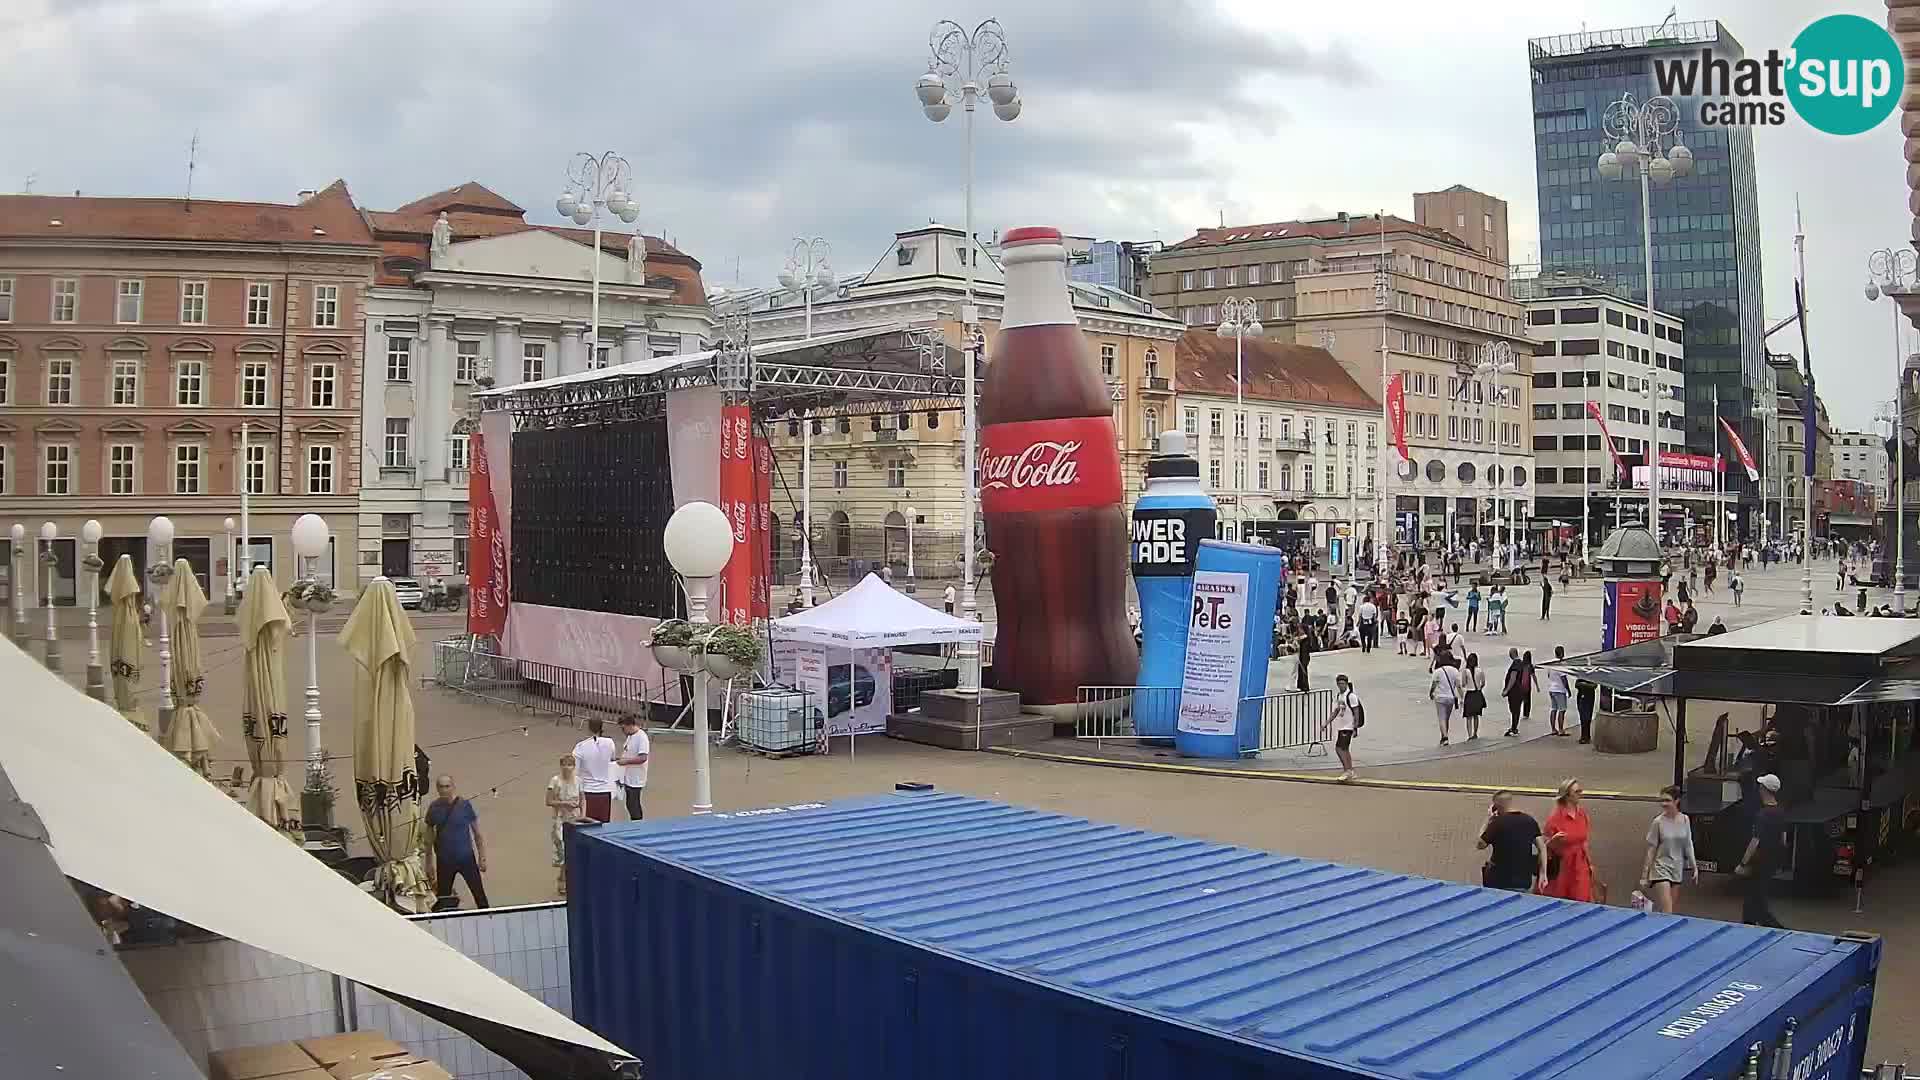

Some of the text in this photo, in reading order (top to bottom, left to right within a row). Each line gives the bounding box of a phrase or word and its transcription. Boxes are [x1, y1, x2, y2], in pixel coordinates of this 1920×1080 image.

[734, 416, 748, 459] Coca-Cola
[734, 500, 746, 543] Coca-Cola
[1657, 1016, 1708, 1039] MCDU
[1690, 989, 1746, 1018] 300629
